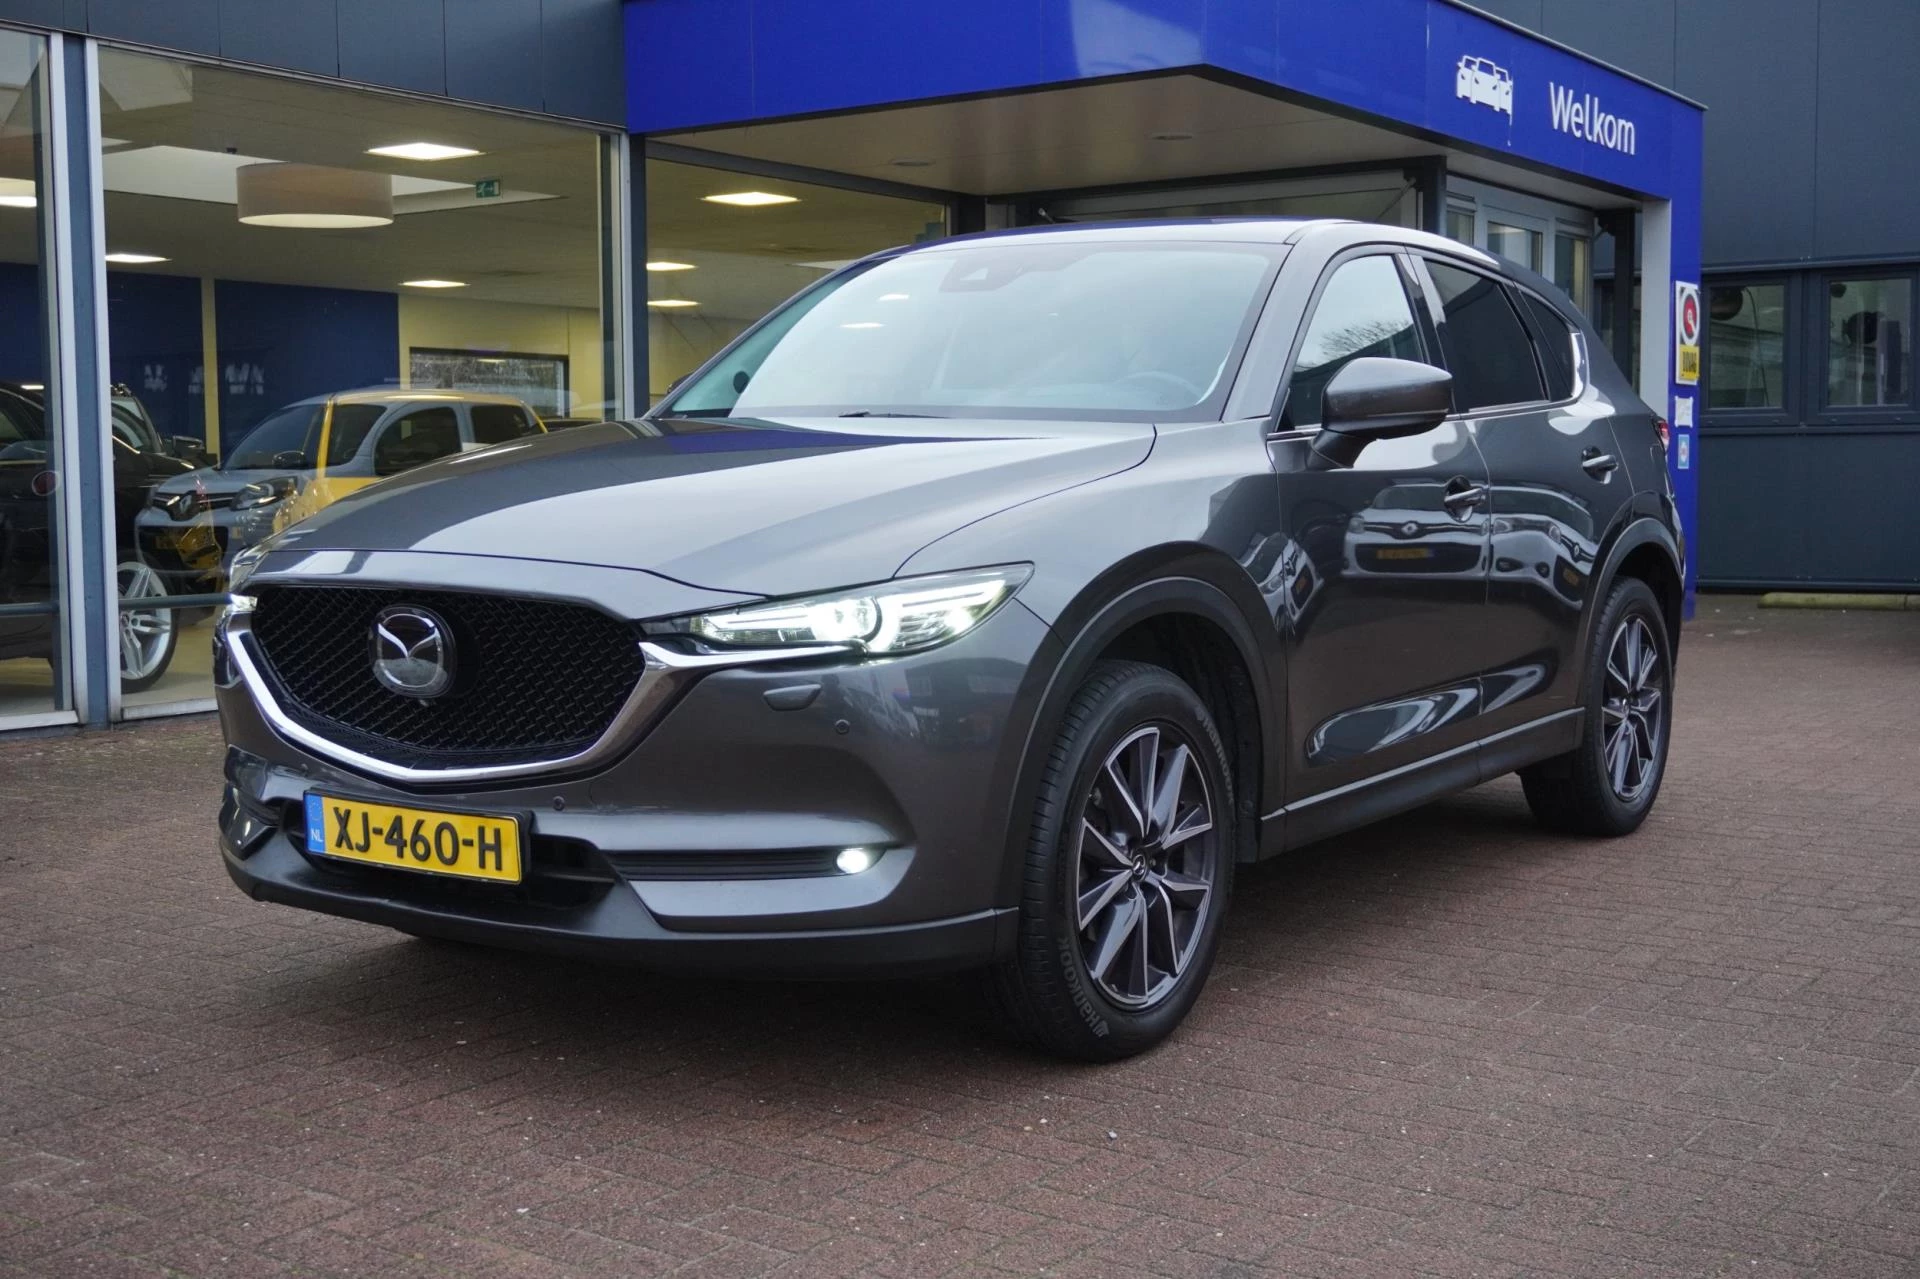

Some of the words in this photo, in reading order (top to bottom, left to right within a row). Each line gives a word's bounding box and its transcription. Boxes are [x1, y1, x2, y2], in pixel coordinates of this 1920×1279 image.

[1549, 81, 1636, 156] Welkom
[310, 828, 324, 844] NL
[333, 807, 503, 871] XJ-460-H
